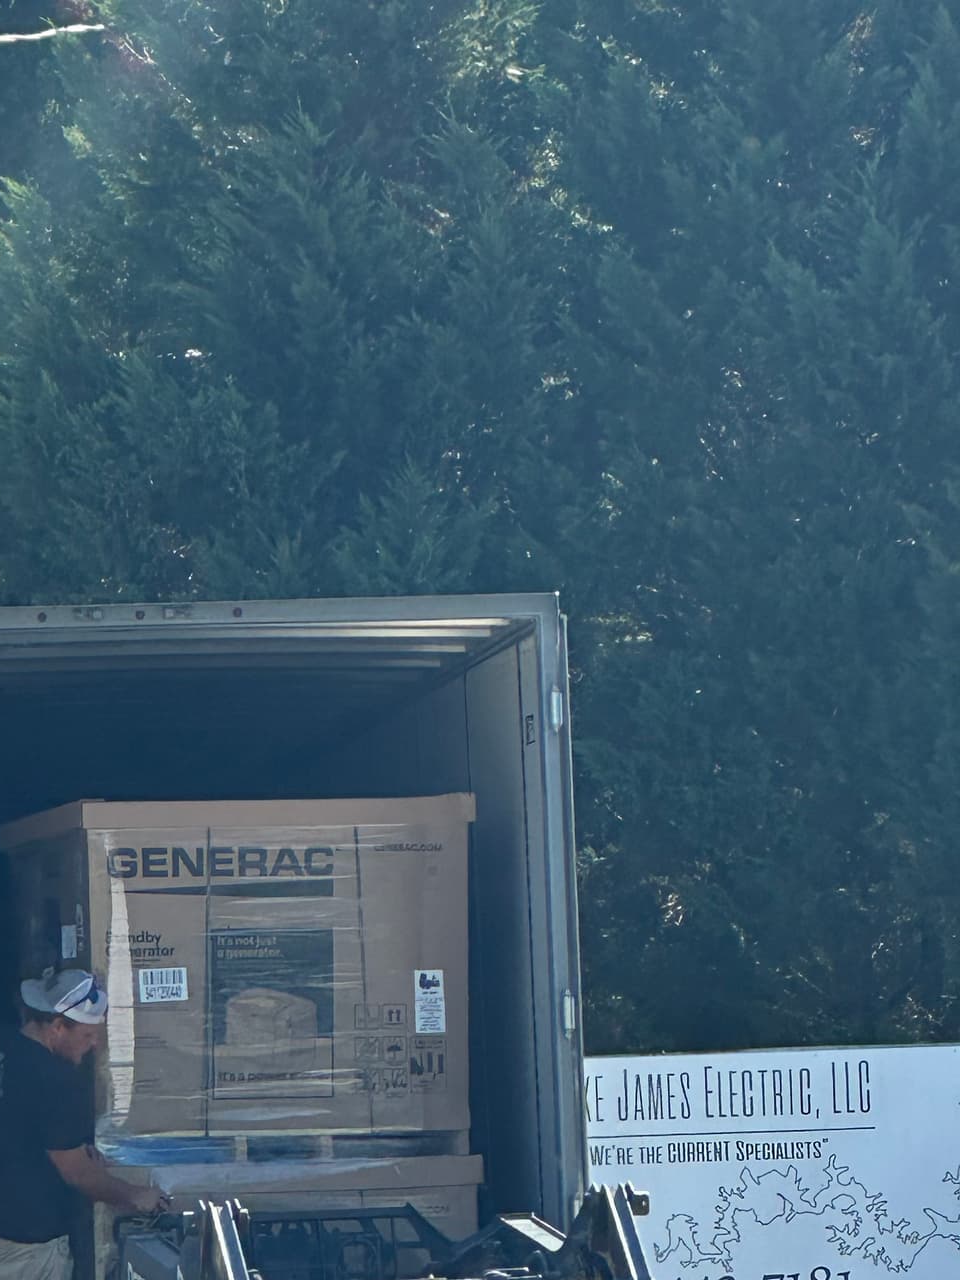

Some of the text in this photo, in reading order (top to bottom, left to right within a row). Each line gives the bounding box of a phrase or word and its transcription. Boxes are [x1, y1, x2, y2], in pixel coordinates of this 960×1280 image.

[106, 847, 334, 879] GENERAC
[585, 1075, 605, 1122] KE
[831, 1060, 871, 1114] LLC
[668, 1140, 730, 1163] CURRENT
